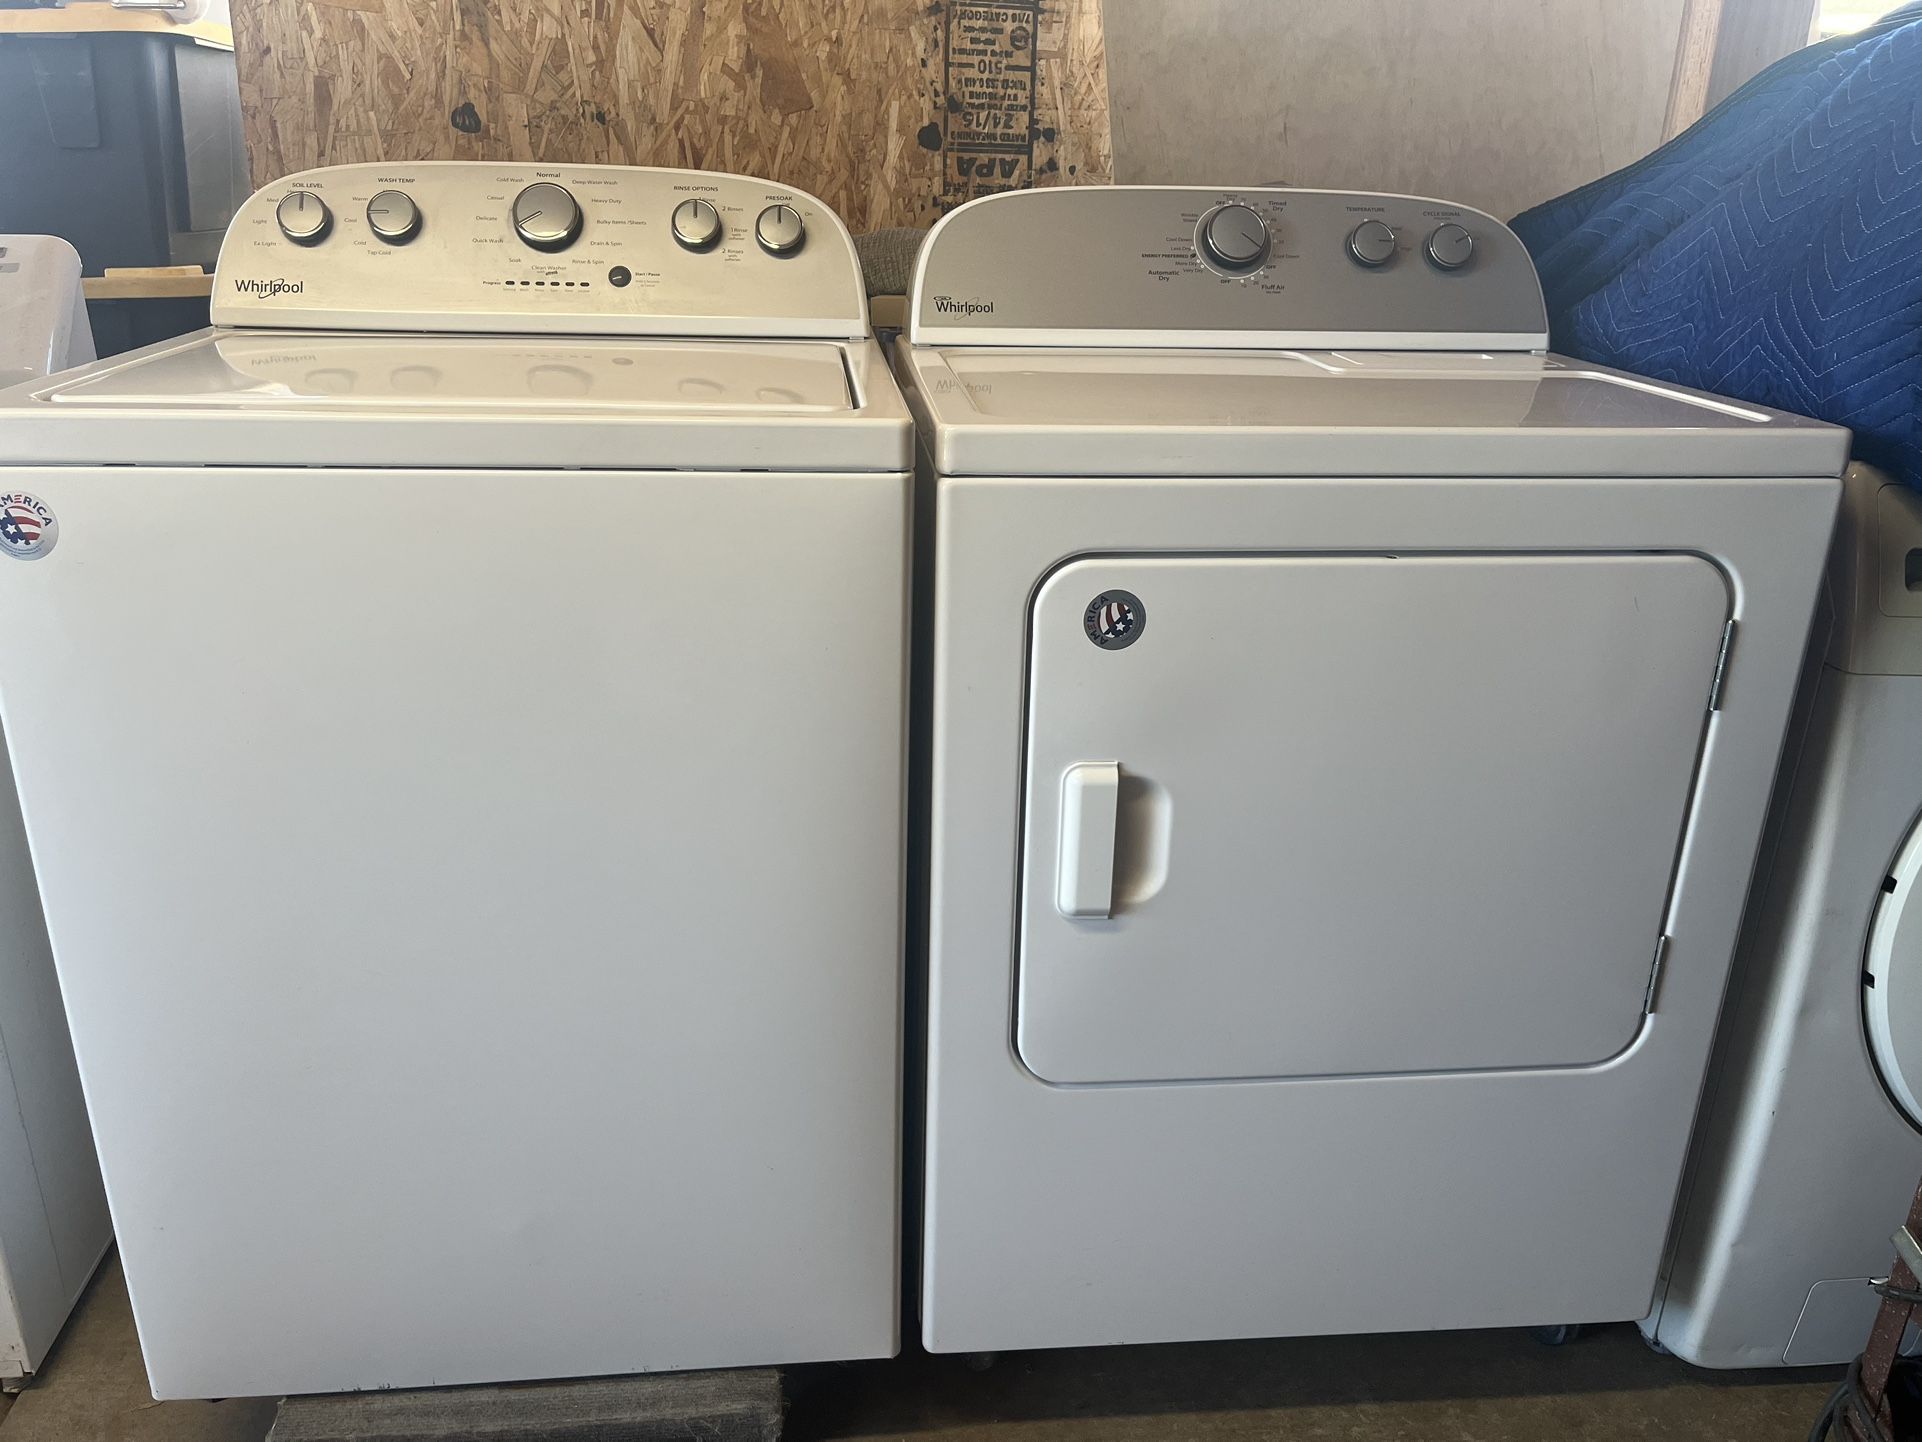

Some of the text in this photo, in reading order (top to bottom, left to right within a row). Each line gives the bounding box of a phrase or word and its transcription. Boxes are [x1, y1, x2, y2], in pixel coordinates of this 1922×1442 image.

[978, 59, 1003, 75] 510
[956, 156, 1020, 179] APA
[235, 279, 304, 298] Whirlpool
[935, 300, 994, 317] Whirlpool
[1087, 595, 1109, 645] AMERICA
